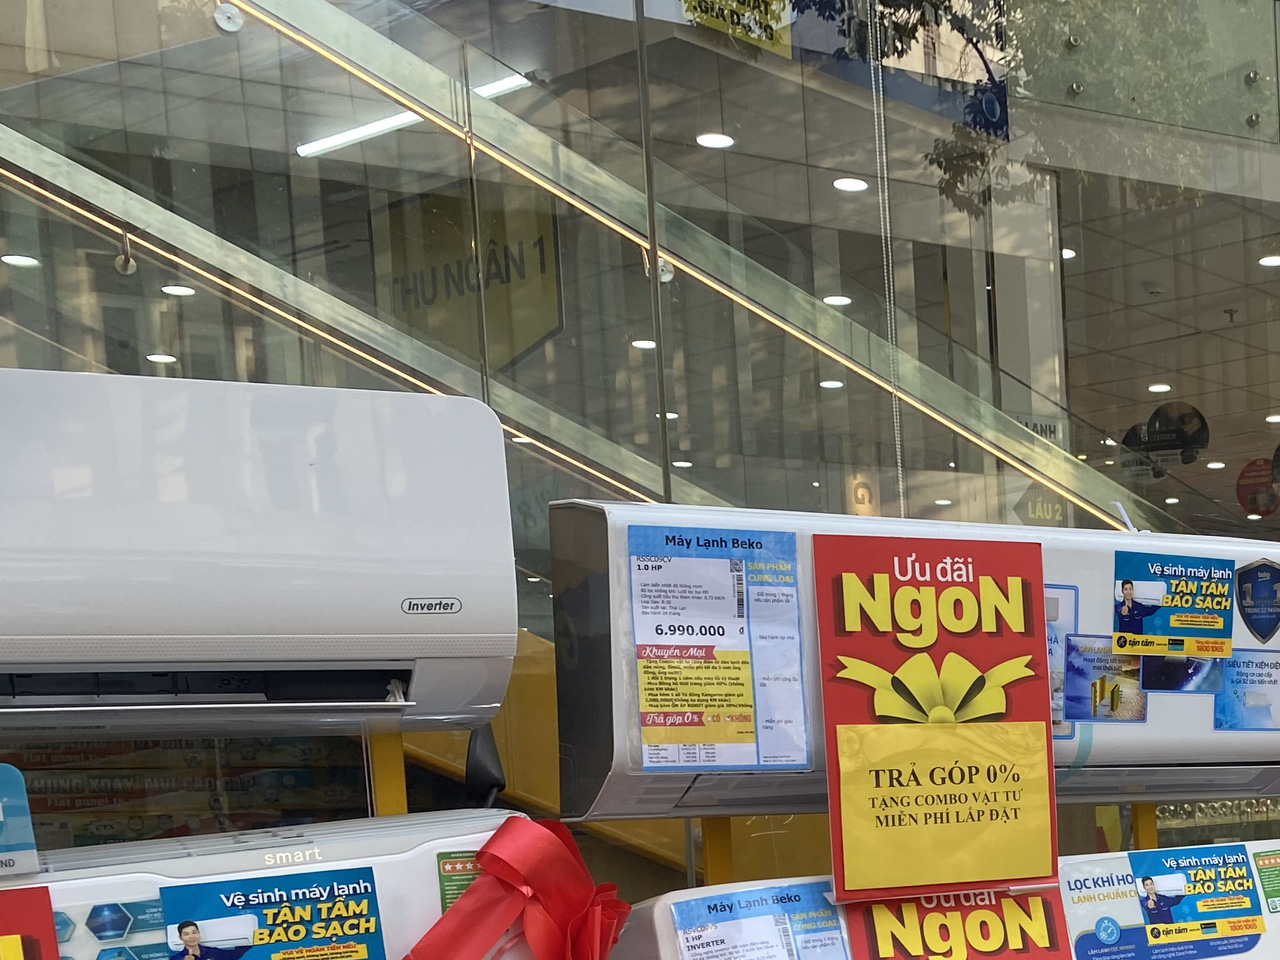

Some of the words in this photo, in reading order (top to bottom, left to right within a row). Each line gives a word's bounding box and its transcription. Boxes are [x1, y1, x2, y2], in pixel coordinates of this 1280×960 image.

[665, 535, 692, 548] Máy
[697, 536, 727, 550] Lạnh
[732, 539, 763, 550] Beko
[894, 558, 930, 582] Ưu
[935, 556, 973, 582] đãi
[408, 601, 455, 611] Inverter
[655, 624, 725, 637] 6.990.000
[642, 646, 681, 657] Khuyến
[646, 712, 664, 724] Trả
[667, 714, 683, 725] góp
[684, 712, 698, 723] 0%
[869, 761, 921, 789] TRẢ
[929, 761, 980, 786] GÓP
[988, 763, 1020, 783] 0%
[869, 792, 910, 809] TẶNG
[914, 791, 966, 807] COMBO
[967, 789, 999, 805] VẬT
[1003, 788, 1022, 803] TƯ
[875, 809, 913, 828] MIỄN
[916, 807, 951, 826] PHÍ
[955, 807, 985, 824] LẮP
[988, 806, 1020, 824] ĐẶT
[264, 848, 322, 865] smart
[1067, 878, 1094, 893] LỌC
[1096, 873, 1114, 888] KHÍ
[220, 892, 246, 909] Vệ
[248, 889, 287, 905] sinh
[291, 884, 330, 902] máy
[335, 879, 372, 899] lạnh
[262, 903, 311, 928] TẬN
[317, 897, 368, 919] TÂM
[312, 917, 376, 941] SẠCH
